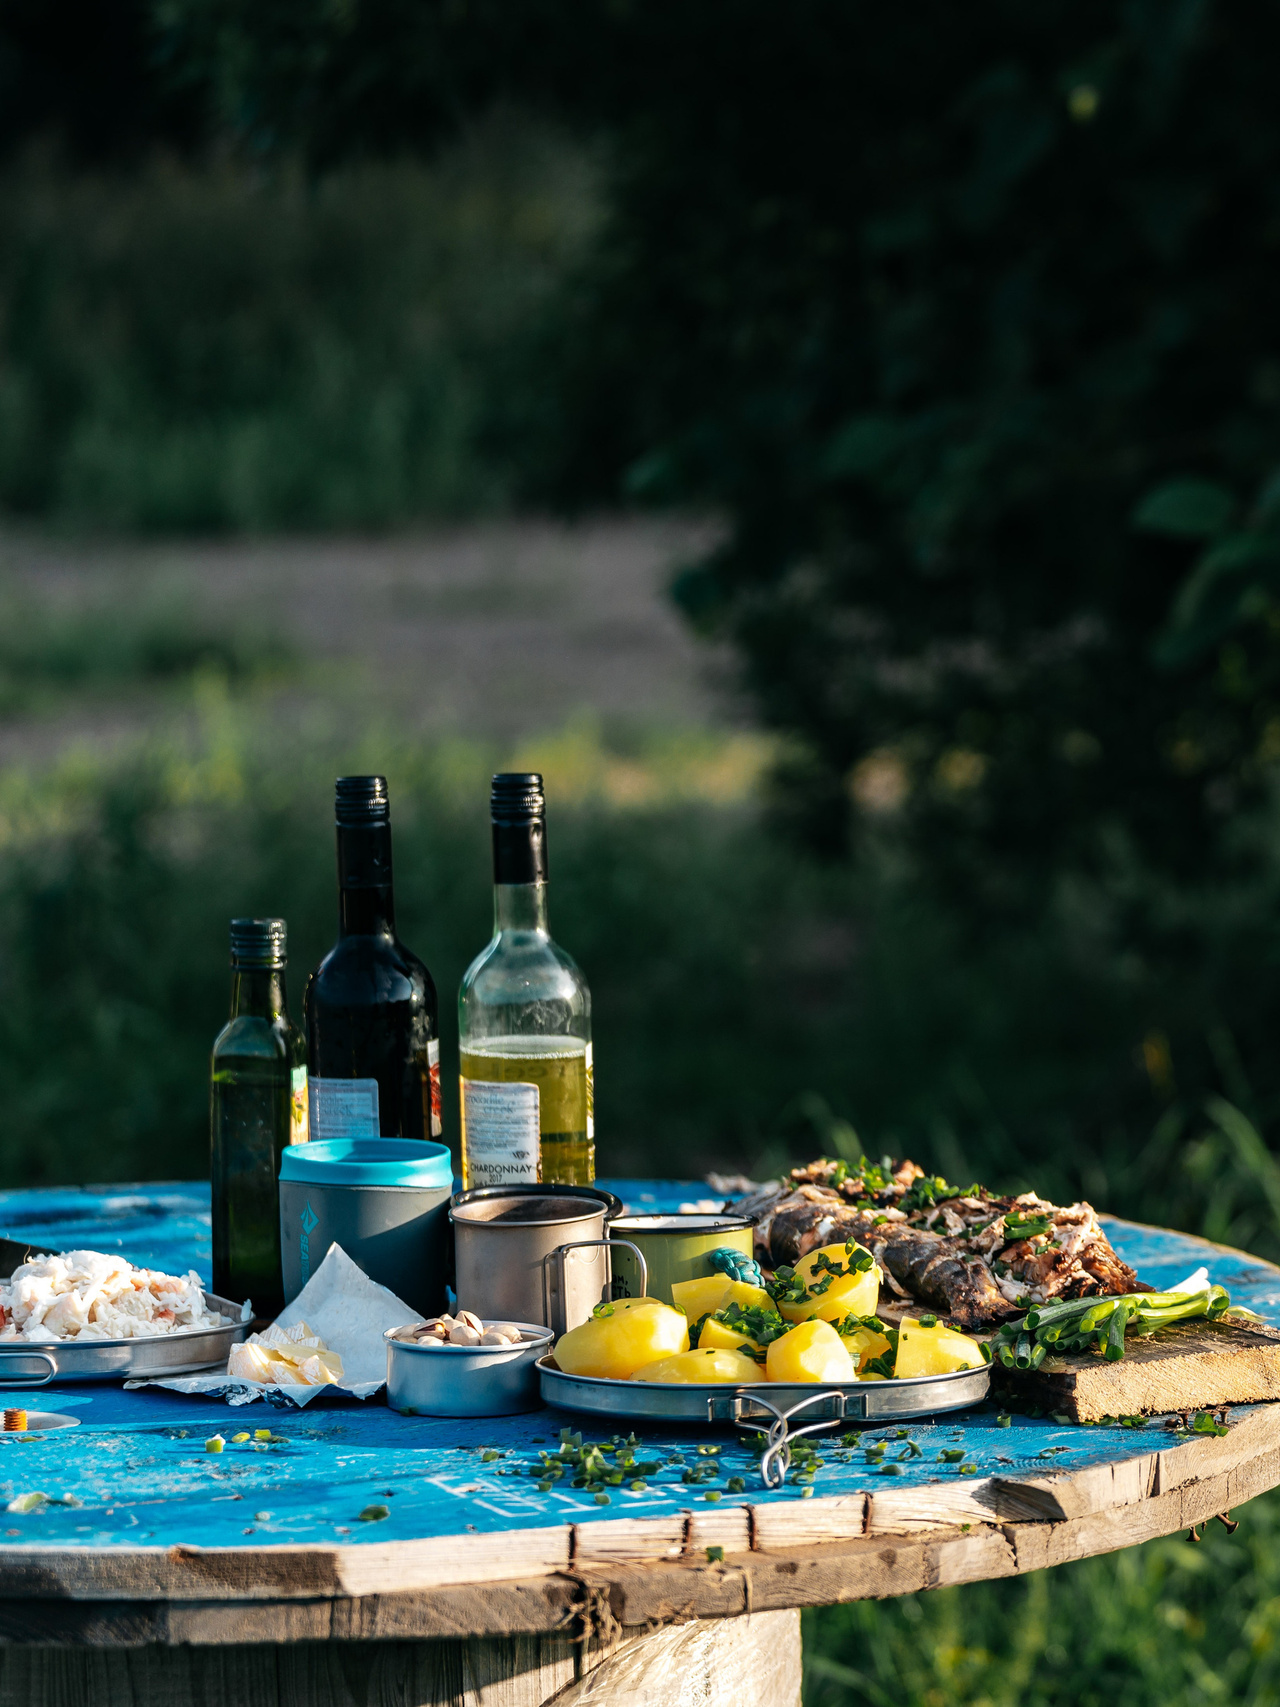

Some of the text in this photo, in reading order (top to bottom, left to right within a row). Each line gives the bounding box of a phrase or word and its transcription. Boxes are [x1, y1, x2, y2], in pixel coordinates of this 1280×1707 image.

[470, 1162, 532, 1174] CHARDONNAY
[489, 1174, 502, 1183] 2017
[300, 1233, 309, 1260] SEA
